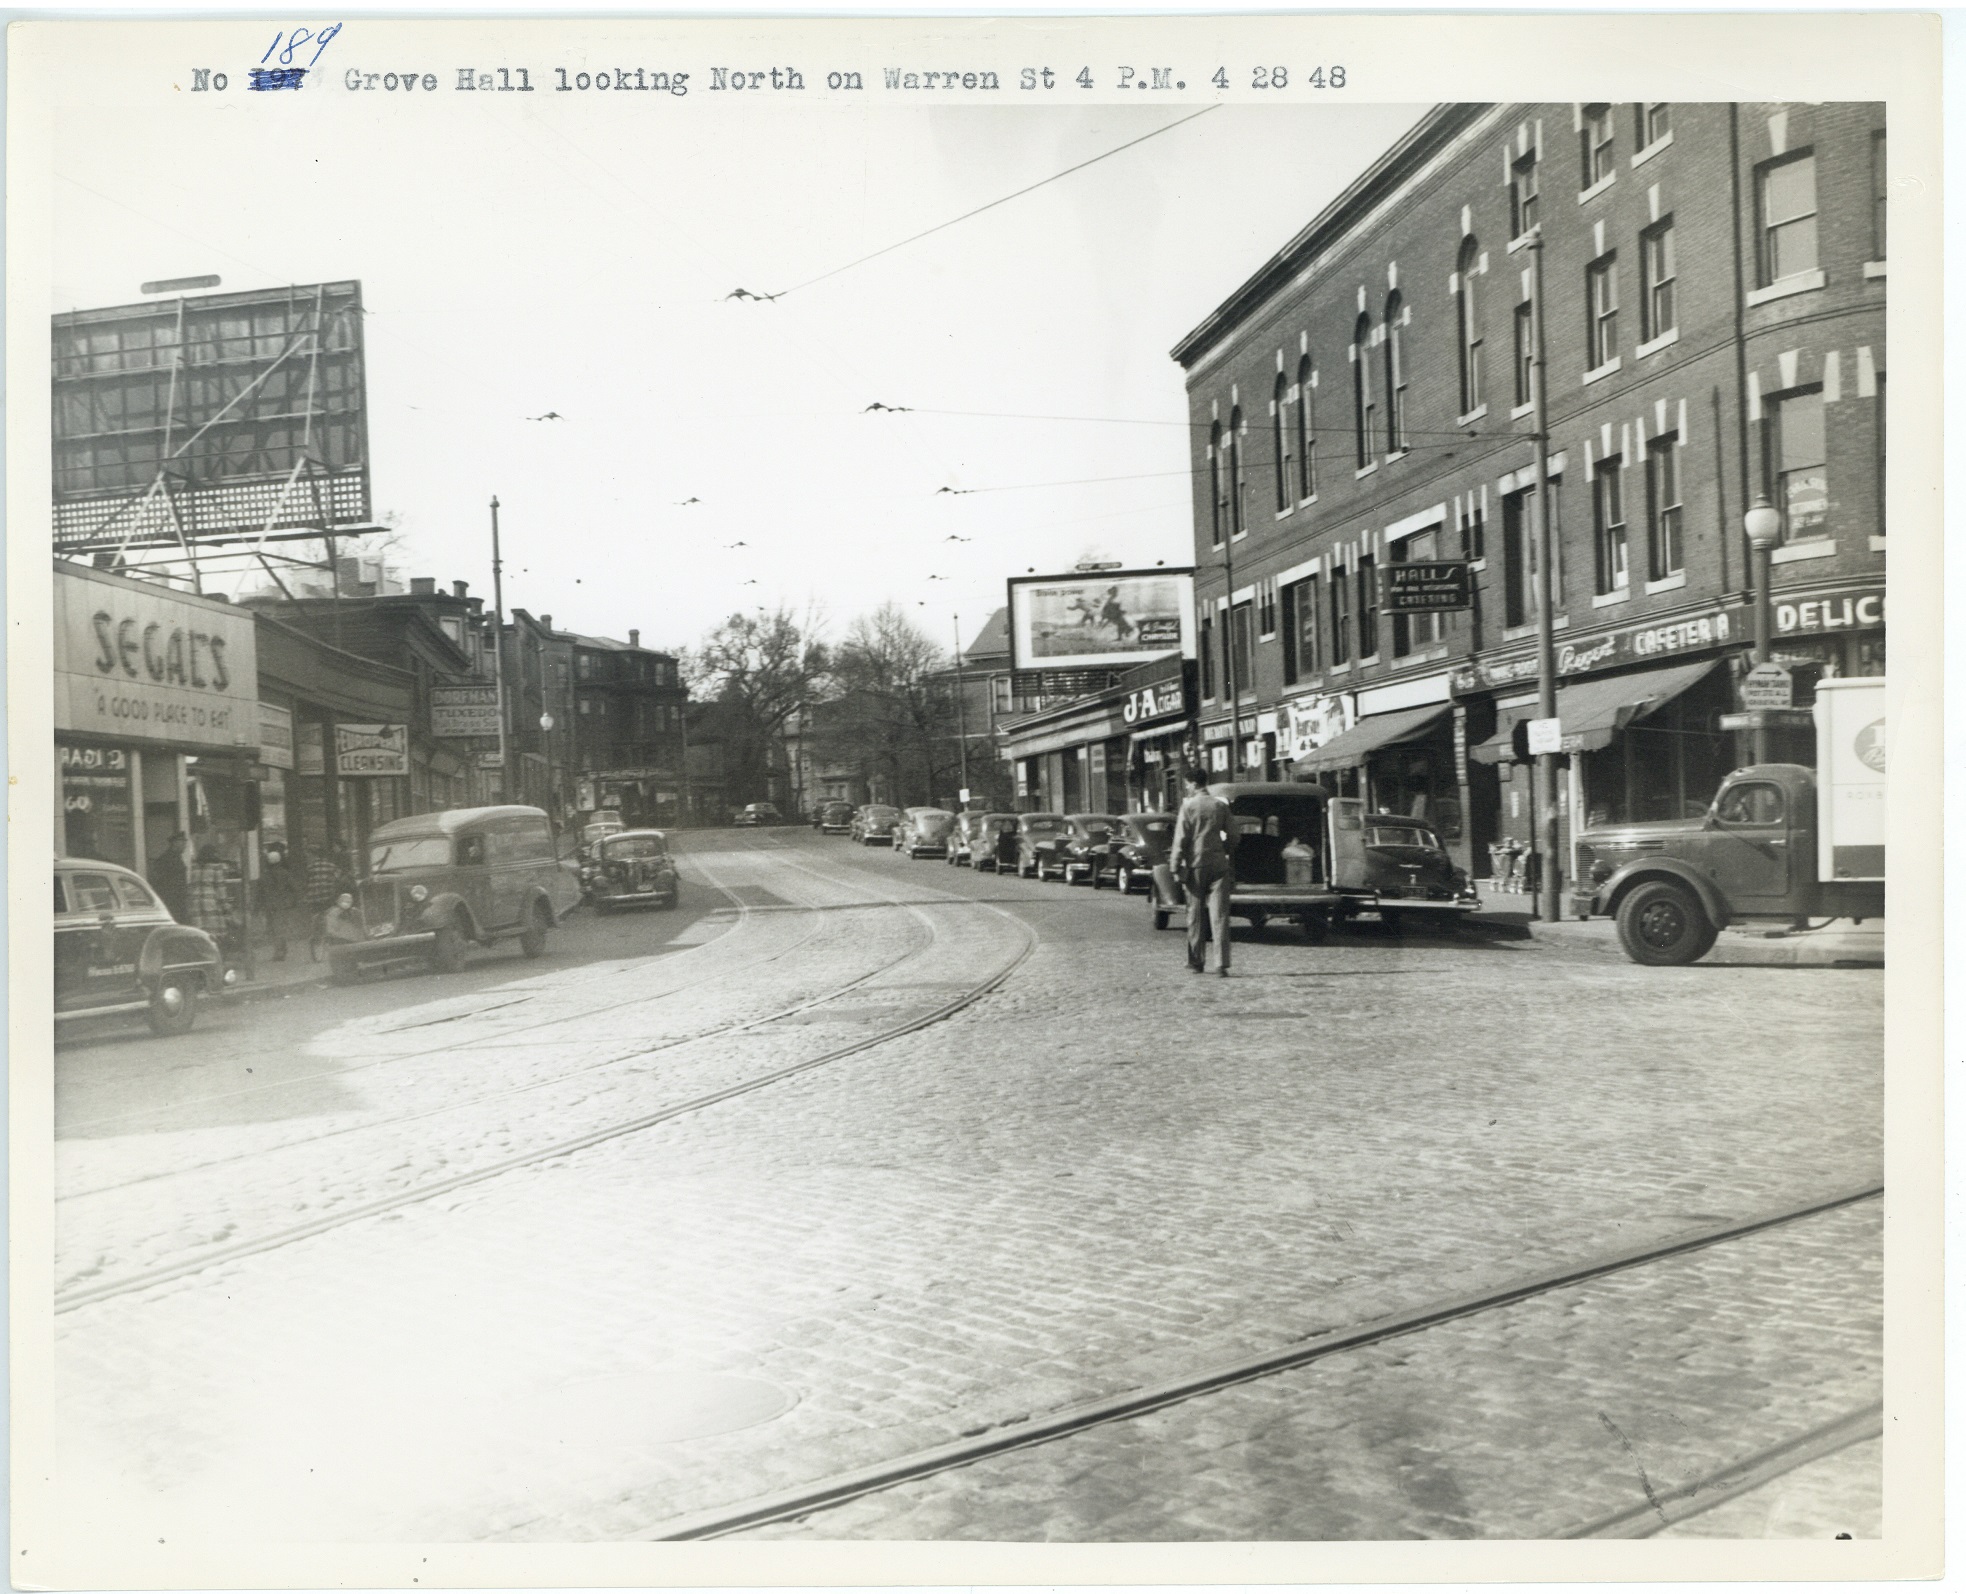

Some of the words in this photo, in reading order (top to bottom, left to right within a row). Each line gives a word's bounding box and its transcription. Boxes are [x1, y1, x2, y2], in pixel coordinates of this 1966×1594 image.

[261, 22, 342, 66] 189
[1777, 595, 1886, 632] DELIC
[112, 697, 149, 720] GOOD
